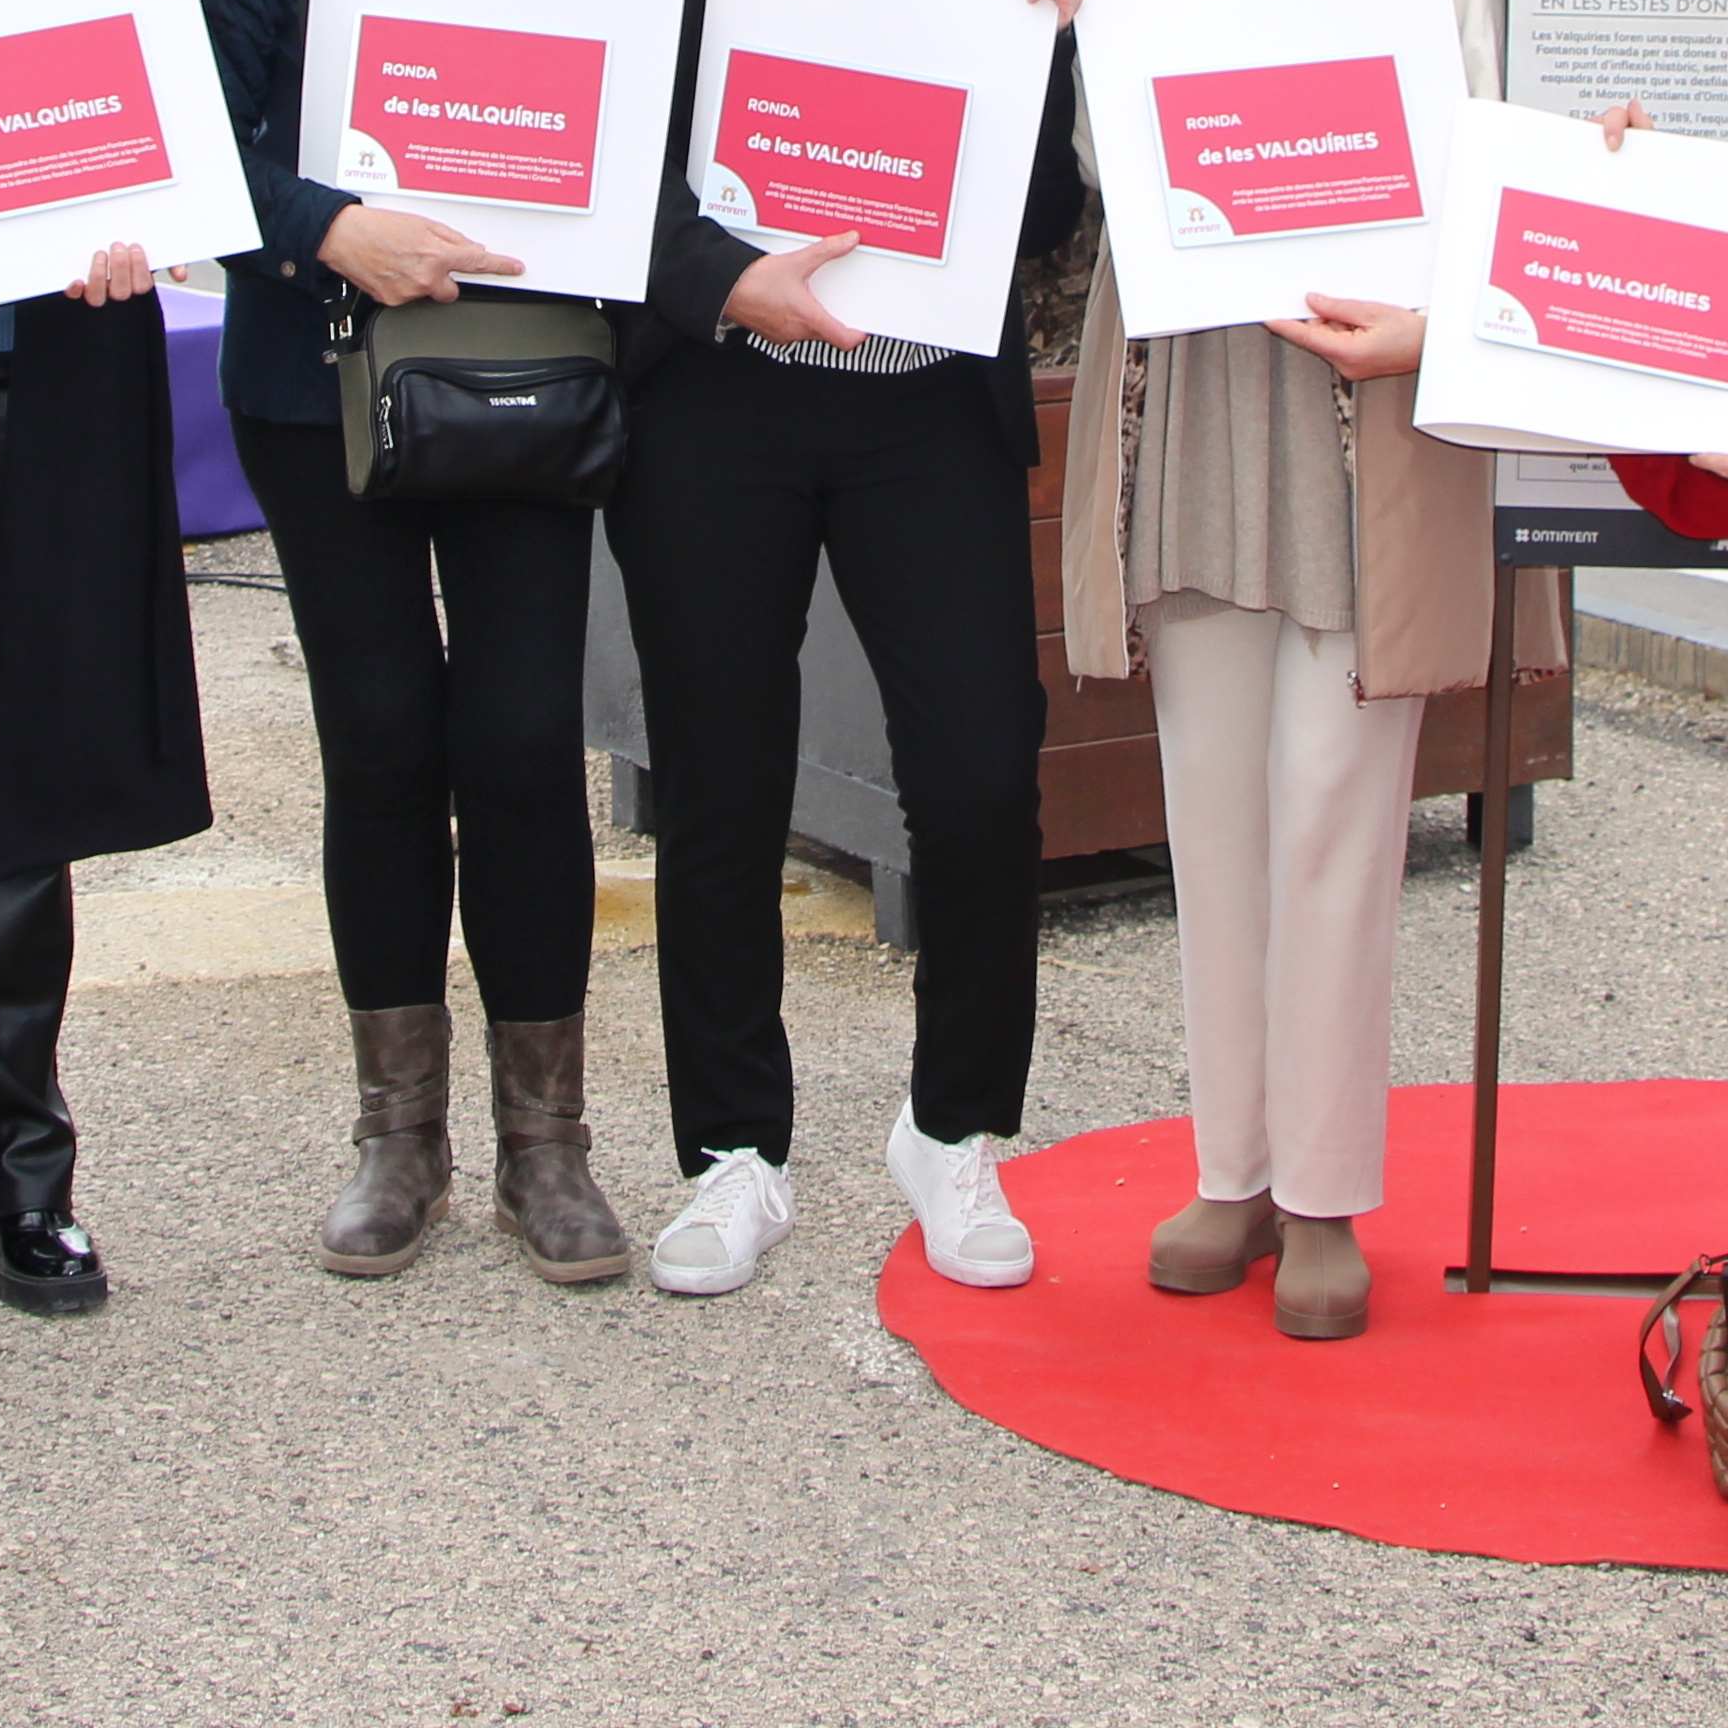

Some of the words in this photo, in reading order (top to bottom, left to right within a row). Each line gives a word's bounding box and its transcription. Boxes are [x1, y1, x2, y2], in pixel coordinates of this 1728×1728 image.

[1532, 30, 1552, 41] Les
[1614, 31, 1644, 42] foren
[1647, 35, 1667, 43] una
[1672, 33, 1722, 46] esquadra
[1535, 44, 1589, 55] Fontanos
[1592, 45, 1639, 57] formada
[1642, 48, 1660, 59] per
[1664, 47, 1680, 57] sis
[1683, 48, 1717, 59] dones
[382, 62, 437, 79] RONDA
[1555, 60, 1569, 69] un
[1572, 60, 1598, 72] punt
[1703, 63, 1728, 72] sent
[1541, 74, 1593, 87] esquadra
[1596, 74, 1609, 84] de
[1613, 75, 1647, 85] dones
[1650, 78, 1670, 88] que
[1674, 78, 1687, 86] va
[1579, 89, 1592, 99] de
[1596, 89, 1631, 99] Moros
[1641, 90, 1691, 101] Cristians
[383, 95, 409, 114] de
[412, 98, 440, 117] les
[444, 101, 565, 130] VALQUÍRIES
[747, 97, 799, 118] RONDA
[1185, 113, 1241, 129] RONDA
[747, 132, 771, 151] de
[774, 136, 801, 156] les
[805, 141, 923, 178] VALQUÍRIES
[1197, 148, 1222, 165] de
[1224, 146, 1254, 162] les
[1255, 131, 1378, 158] VALQUÍRIES
[1522, 230, 1578, 251] RONDA
[1524, 260, 1550, 278] de
[1552, 265, 1581, 285] les
[1586, 271, 1710, 311] VALQUÍRIES
